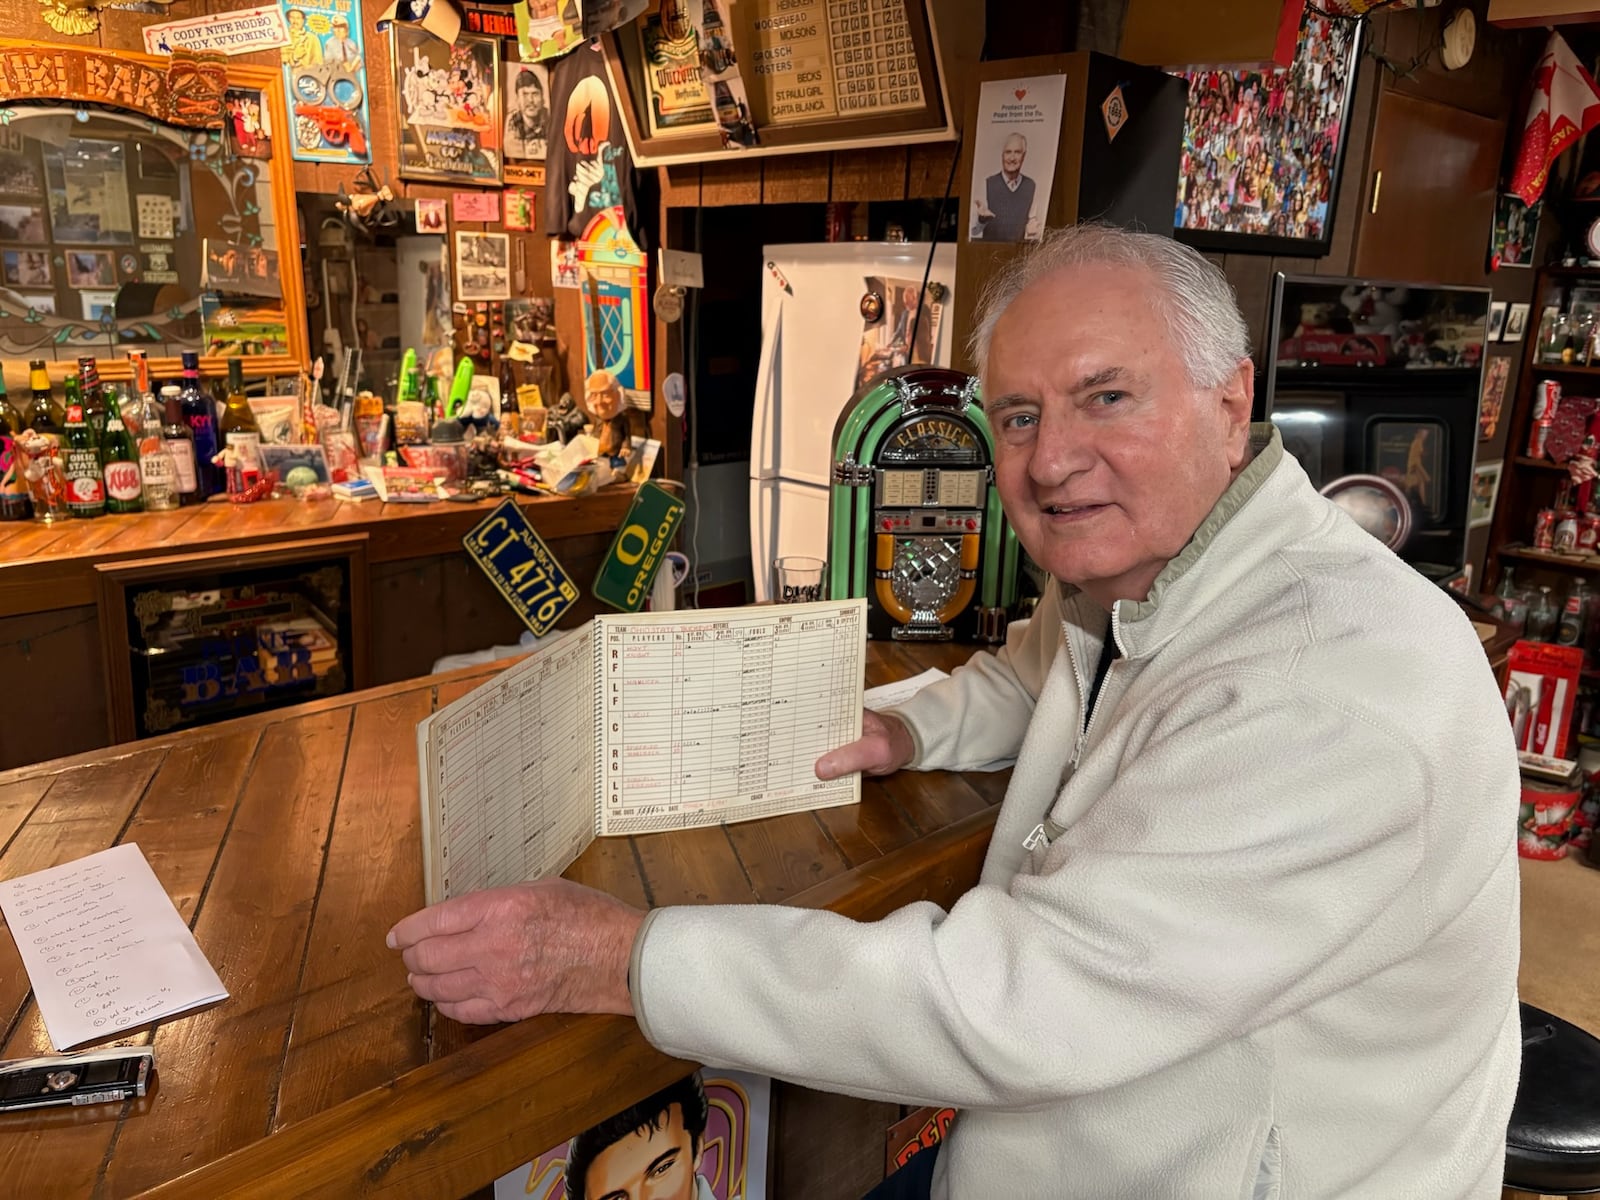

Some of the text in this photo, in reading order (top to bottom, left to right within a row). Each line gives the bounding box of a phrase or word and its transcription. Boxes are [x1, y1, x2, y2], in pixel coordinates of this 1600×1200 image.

[173, 16, 272, 41] CODY NITE RODEO
[754, 12, 807, 31] MOOSEHEAD
[214, 27, 276, 47] WYOMING
[780, 25, 816, 40] MOLSONS
[753, 46, 792, 61] GROLSCH
[754, 60, 792, 75] FOSTERS
[796, 70, 822, 83] BECKS
[85, 55, 161, 115] BAR
[771, 100, 825, 115] CARTA BLANCA
[896, 420, 970, 447] CLASSICS
[69, 453, 95, 462] OHIO
[68, 461, 98, 470] STATE
[519, 527, 556, 581] ALASKA
[626, 505, 679, 605] OREGON
[477, 517, 564, 622] CT 4776
[612, 649, 618, 659] R
[612, 663, 618, 672] F
[613, 683, 619, 692] L
[612, 696, 618, 706] F
[450, 717, 471, 736] PLAYERS
[612, 723, 618, 732] C
[612, 749, 618, 758] R
[612, 762, 618, 771] G
[613, 781, 619, 790] L
[612, 794, 618, 803] G
